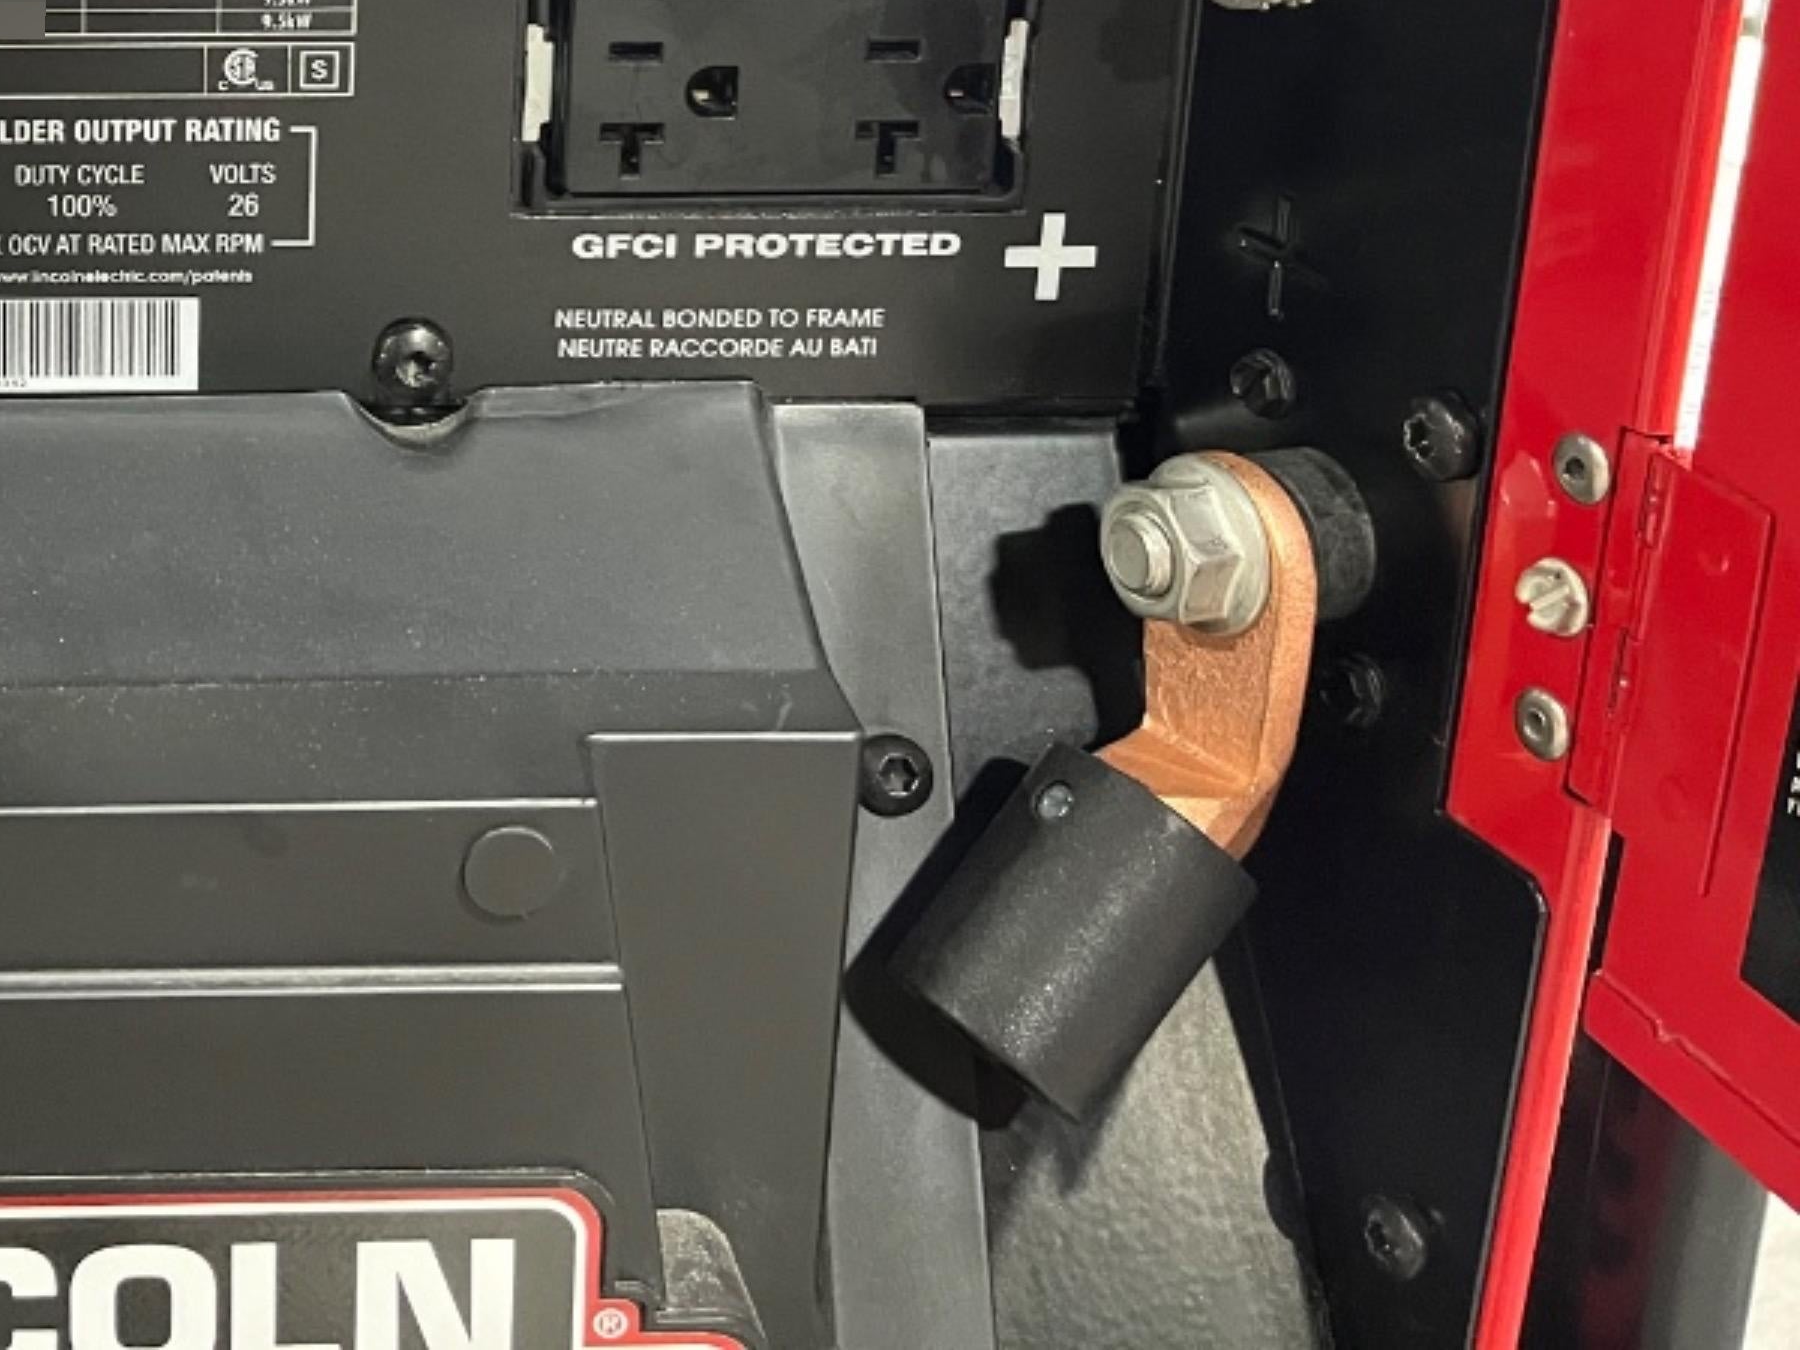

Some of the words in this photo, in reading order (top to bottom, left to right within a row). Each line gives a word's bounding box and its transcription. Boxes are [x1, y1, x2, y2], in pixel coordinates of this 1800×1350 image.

[310, 58, 329, 80] S
[74, 119, 176, 143] OUTPUT
[184, 118, 281, 143] RATING
[14, 164, 70, 186] DUTY
[77, 164, 145, 185] CYCLE
[209, 163, 277, 185] VOLTS
[47, 193, 118, 218] 100%
[227, 193, 260, 218] 26
[8, 235, 51, 256] OCV
[55, 234, 82, 255] AT
[87, 233, 156, 254] RATED
[161, 233, 211, 254] MAX
[215, 232, 265, 254] RPM
[571, 232, 677, 259] GFCI
[695, 232, 962, 259] PROTECTED
[554, 308, 655, 330] NEUTRAL
[663, 308, 762, 329] BONDED
[768, 308, 799, 328] TO
[806, 307, 886, 328] FRAME
[558, 338, 643, 358] NEUTRE
[649, 337, 783, 358] RACCORDE
[789, 337, 823, 357] AU
[830, 337, 877, 357] BATI
